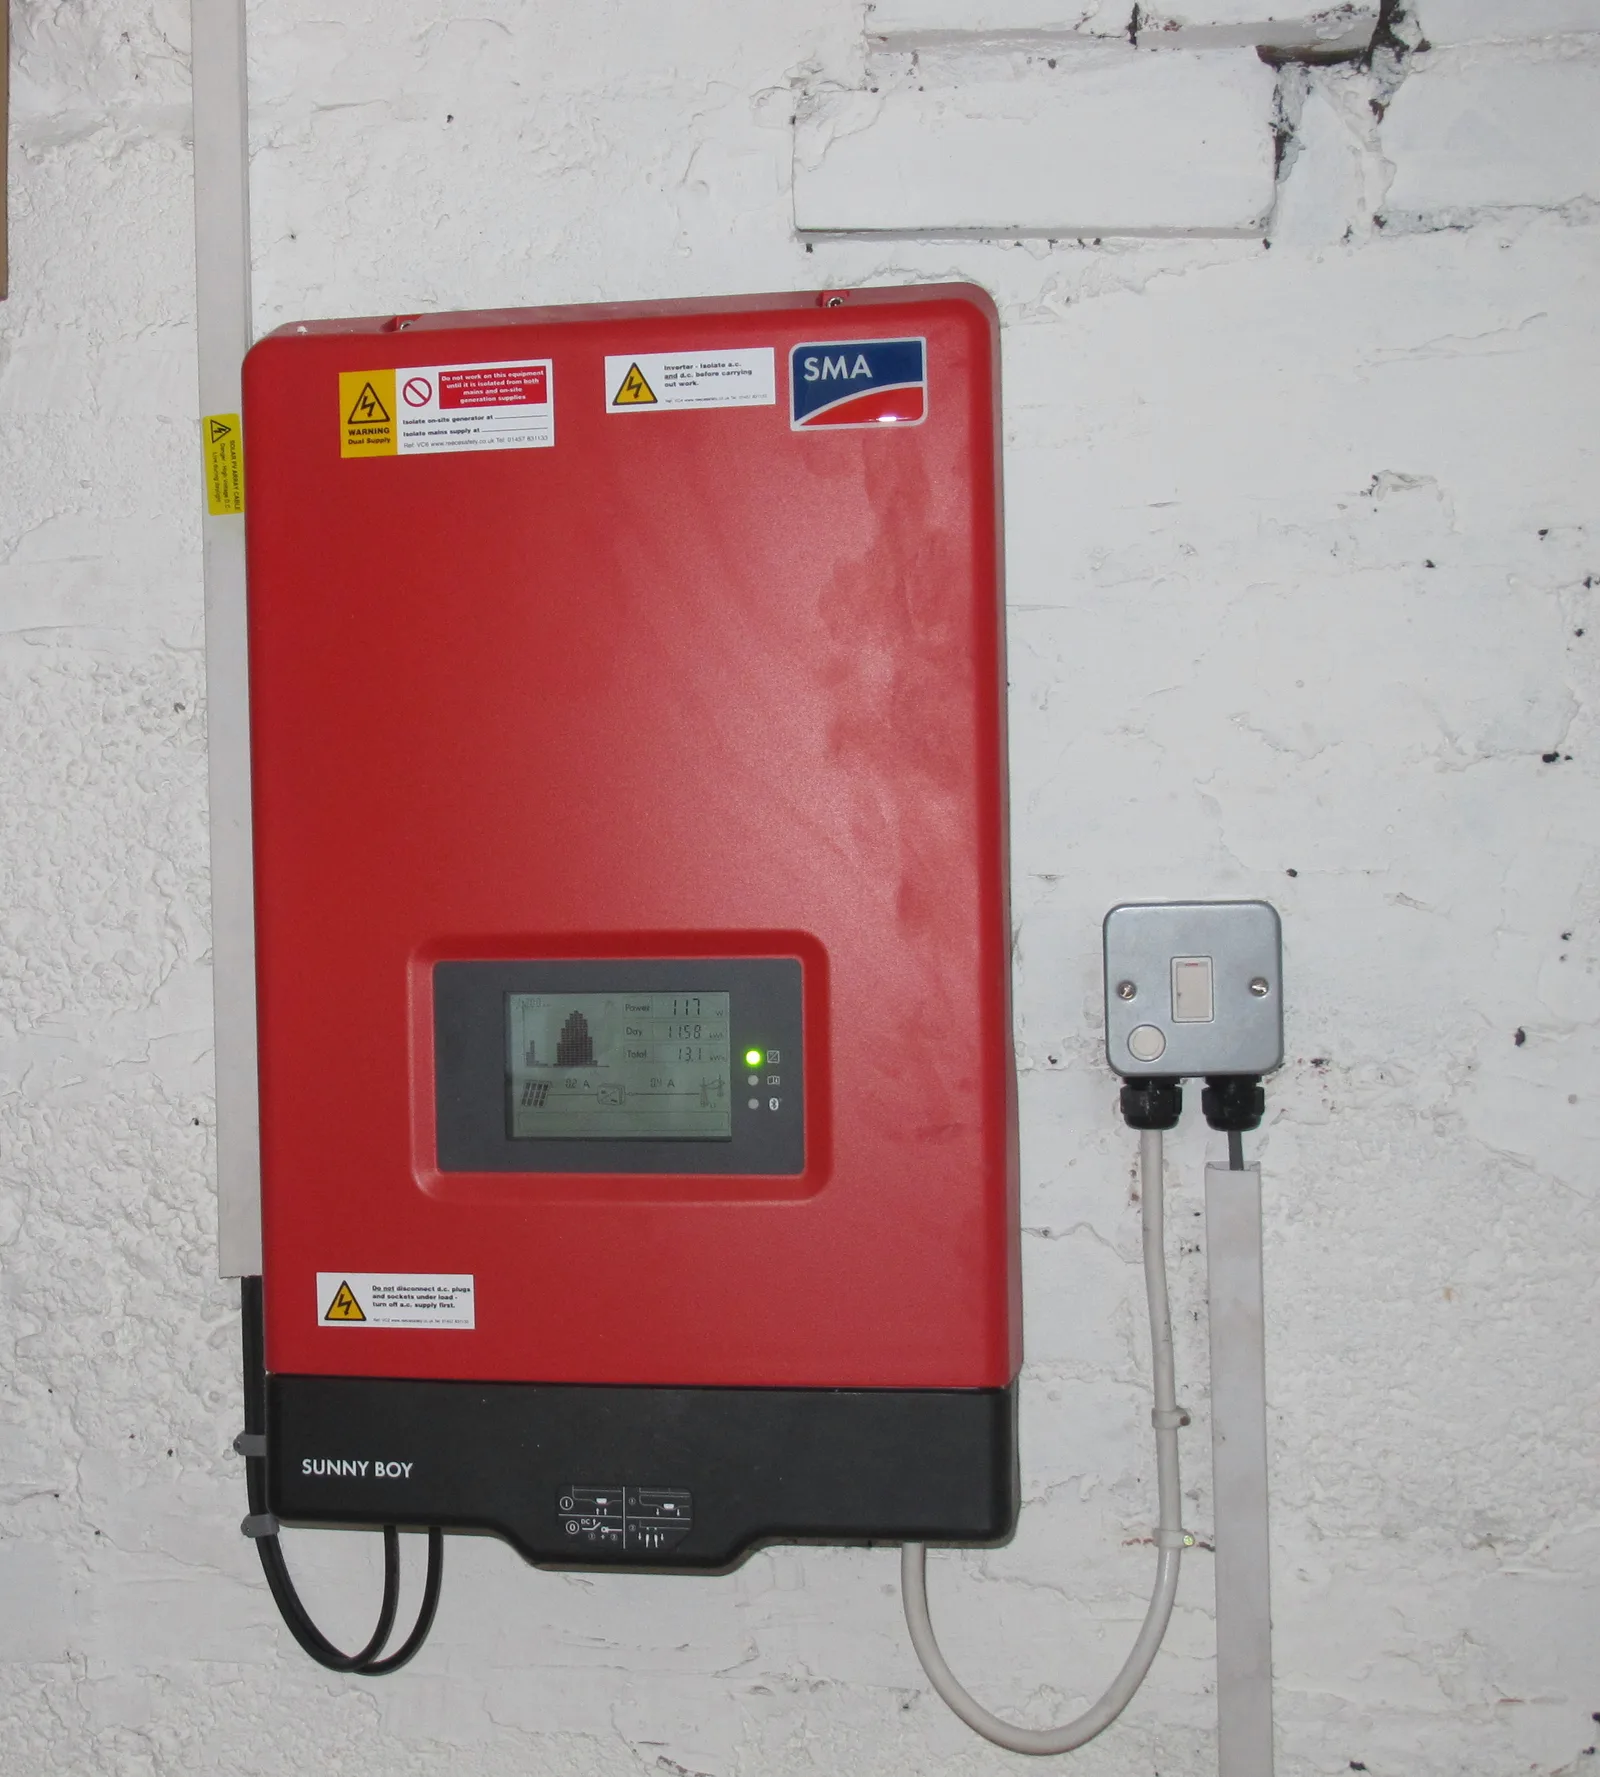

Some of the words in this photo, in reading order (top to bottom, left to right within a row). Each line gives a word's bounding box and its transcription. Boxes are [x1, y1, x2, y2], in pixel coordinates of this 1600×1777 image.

[804, 354, 873, 381] SMA
[460, 396, 496, 404] generation
[674, 998, 700, 1015] 117
[626, 1027, 642, 1036] Day
[627, 1050, 647, 1058] Total
[302, 1458, 369, 1476] SUNNY
[375, 1461, 413, 1478] BOY
